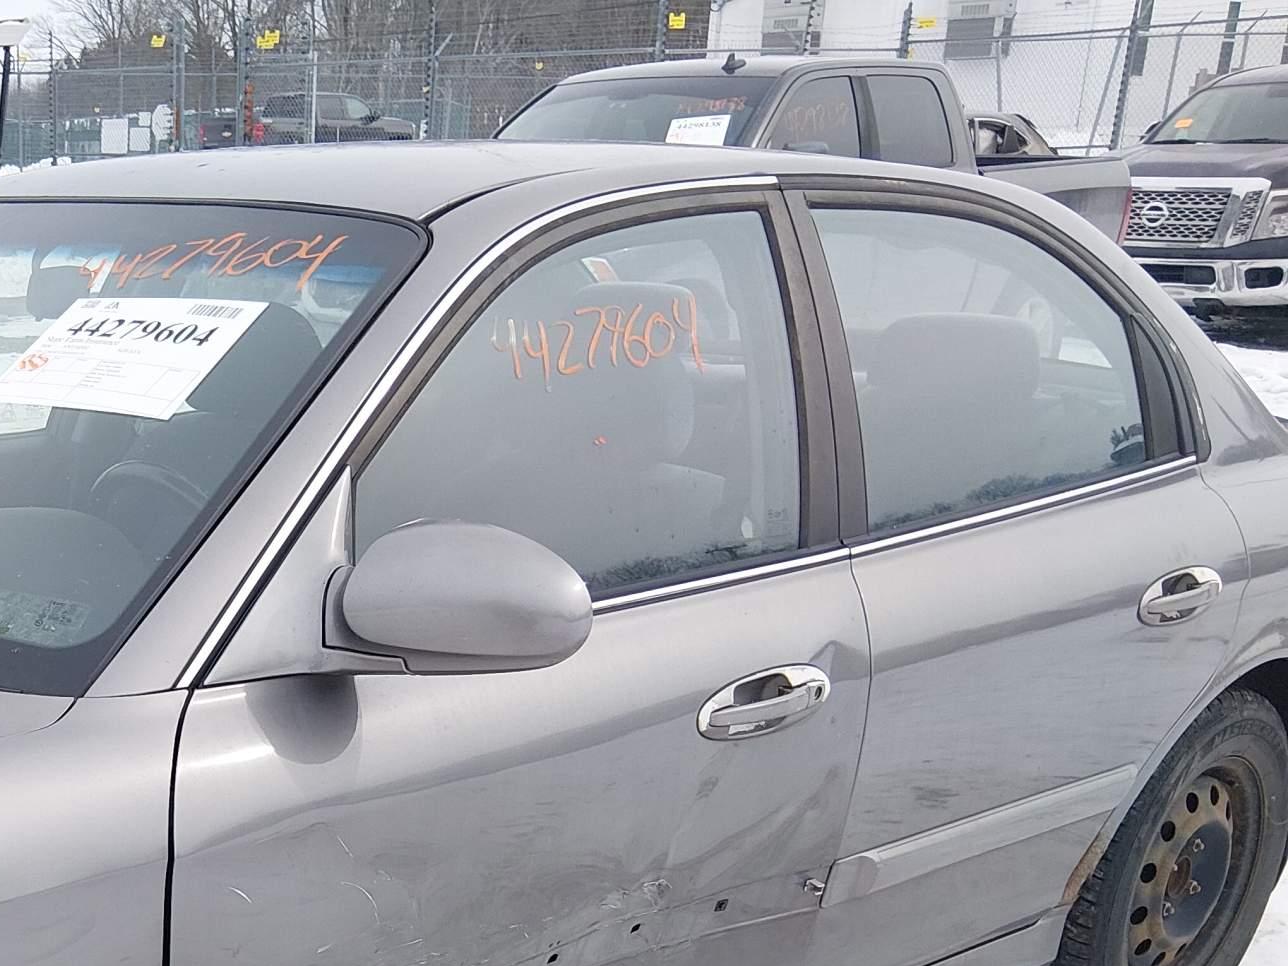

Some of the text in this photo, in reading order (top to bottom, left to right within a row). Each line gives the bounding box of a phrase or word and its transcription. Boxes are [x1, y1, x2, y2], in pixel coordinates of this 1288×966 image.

[79, 231, 349, 293] 44279604
[67, 317, 219, 347] 44279604
[491, 296, 706, 392] 44279604
